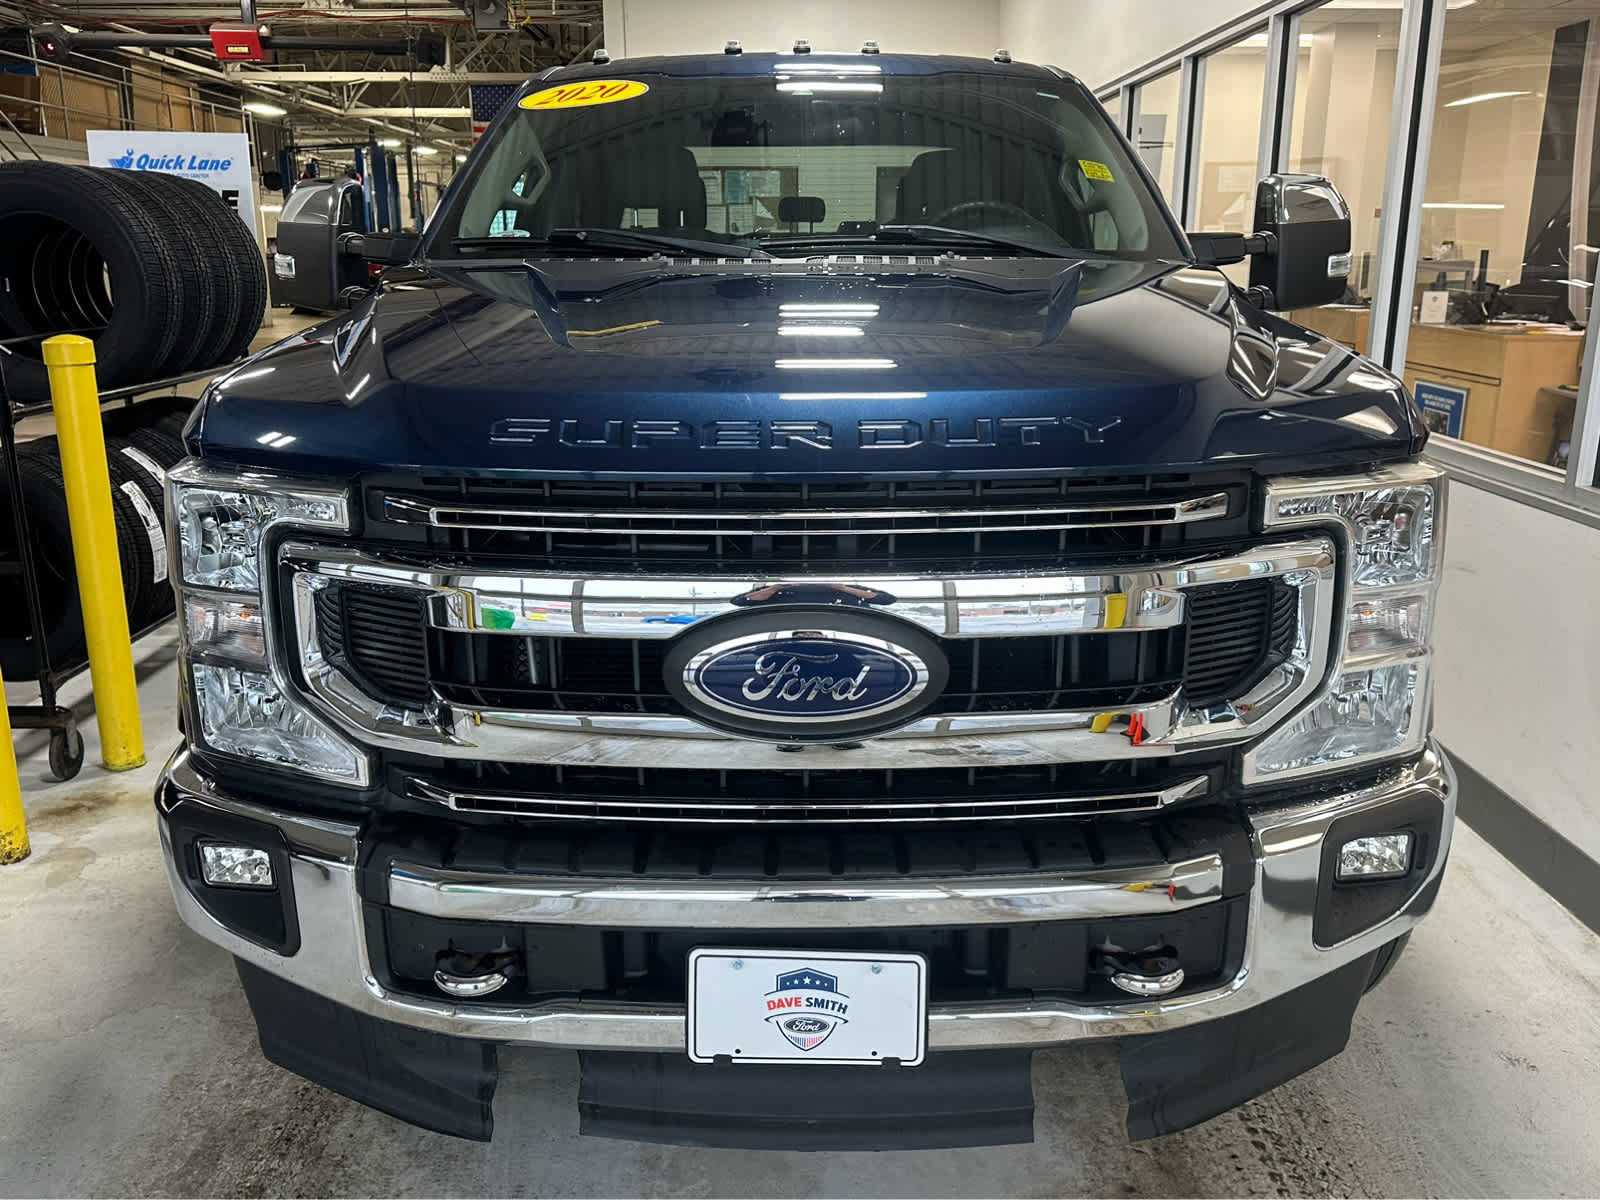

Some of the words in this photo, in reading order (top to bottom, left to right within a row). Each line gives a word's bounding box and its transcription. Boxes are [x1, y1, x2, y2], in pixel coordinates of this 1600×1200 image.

[534, 83, 630, 106] 2020
[136, 154, 184, 170] Quick
[188, 155, 232, 171] Lane
[488, 416, 833, 450] SUPER
[858, 415, 1122, 449] DUTY
[742, 651, 871, 701] Ford
[766, 997, 802, 1011] DAVE
[805, 997, 848, 1014] SMITH
[792, 1019, 820, 1031] Ford
